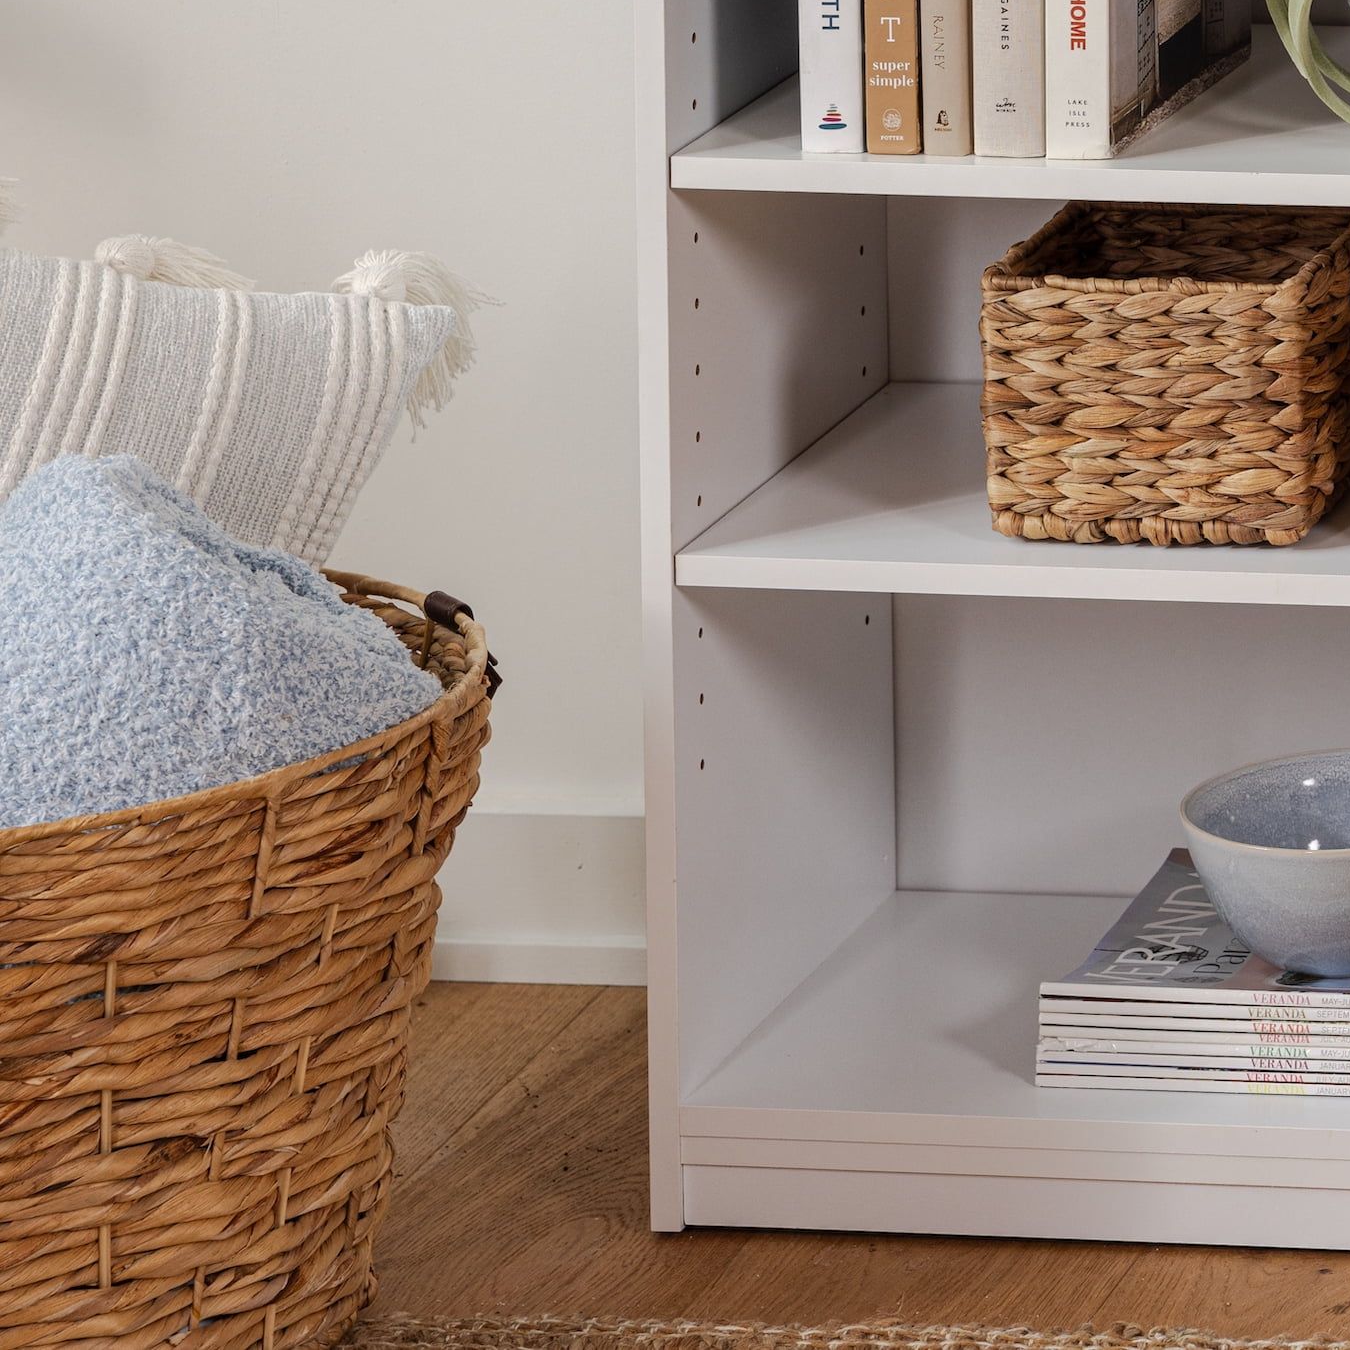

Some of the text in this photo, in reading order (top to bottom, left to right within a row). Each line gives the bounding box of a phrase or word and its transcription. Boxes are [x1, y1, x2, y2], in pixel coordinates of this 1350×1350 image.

[932, 14, 945, 70] RAINEY
[872, 61, 911, 73] super
[869, 74, 914, 89] simple
[1084, 871, 1217, 985] VERAND
[1253, 993, 1311, 1006] VERANDA
[1248, 1007, 1306, 1019] VERANDA
[1253, 1023, 1310, 1034] VERANDA
[1259, 1034, 1310, 1044] VERANDA
[1250, 1046, 1308, 1058] VERANDA
[1251, 1059, 1309, 1070] VERANDA
[1247, 1073, 1304, 1083] VERANDA
[1248, 1084, 1305, 1095] VERANDA
